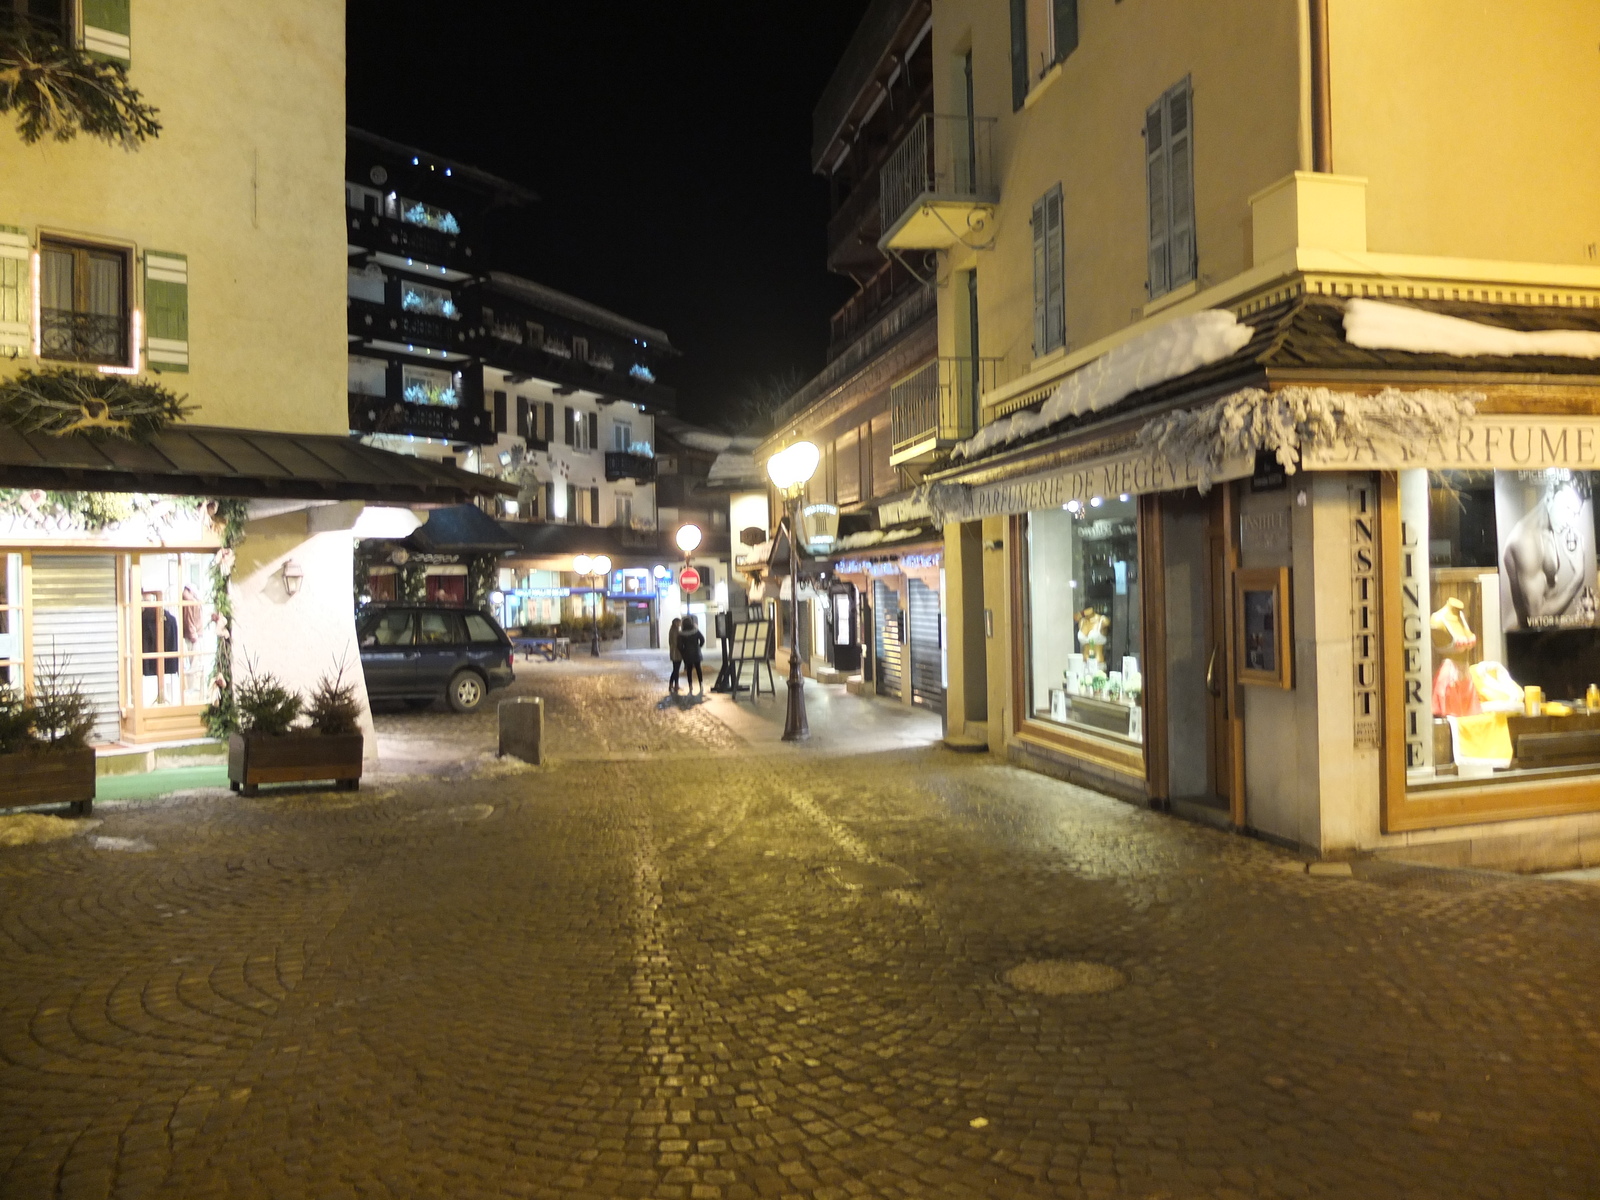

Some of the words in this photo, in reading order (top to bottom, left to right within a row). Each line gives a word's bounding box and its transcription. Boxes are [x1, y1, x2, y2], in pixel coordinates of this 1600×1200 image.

[978, 476, 1064, 515] PARFUMERIE
[1071, 468, 1095, 499] DE
[1354, 489, 1378, 715] INSTITUT
[1401, 521, 1425, 768] LINGERIE
[1526, 615, 1554, 628] VIKTOR
